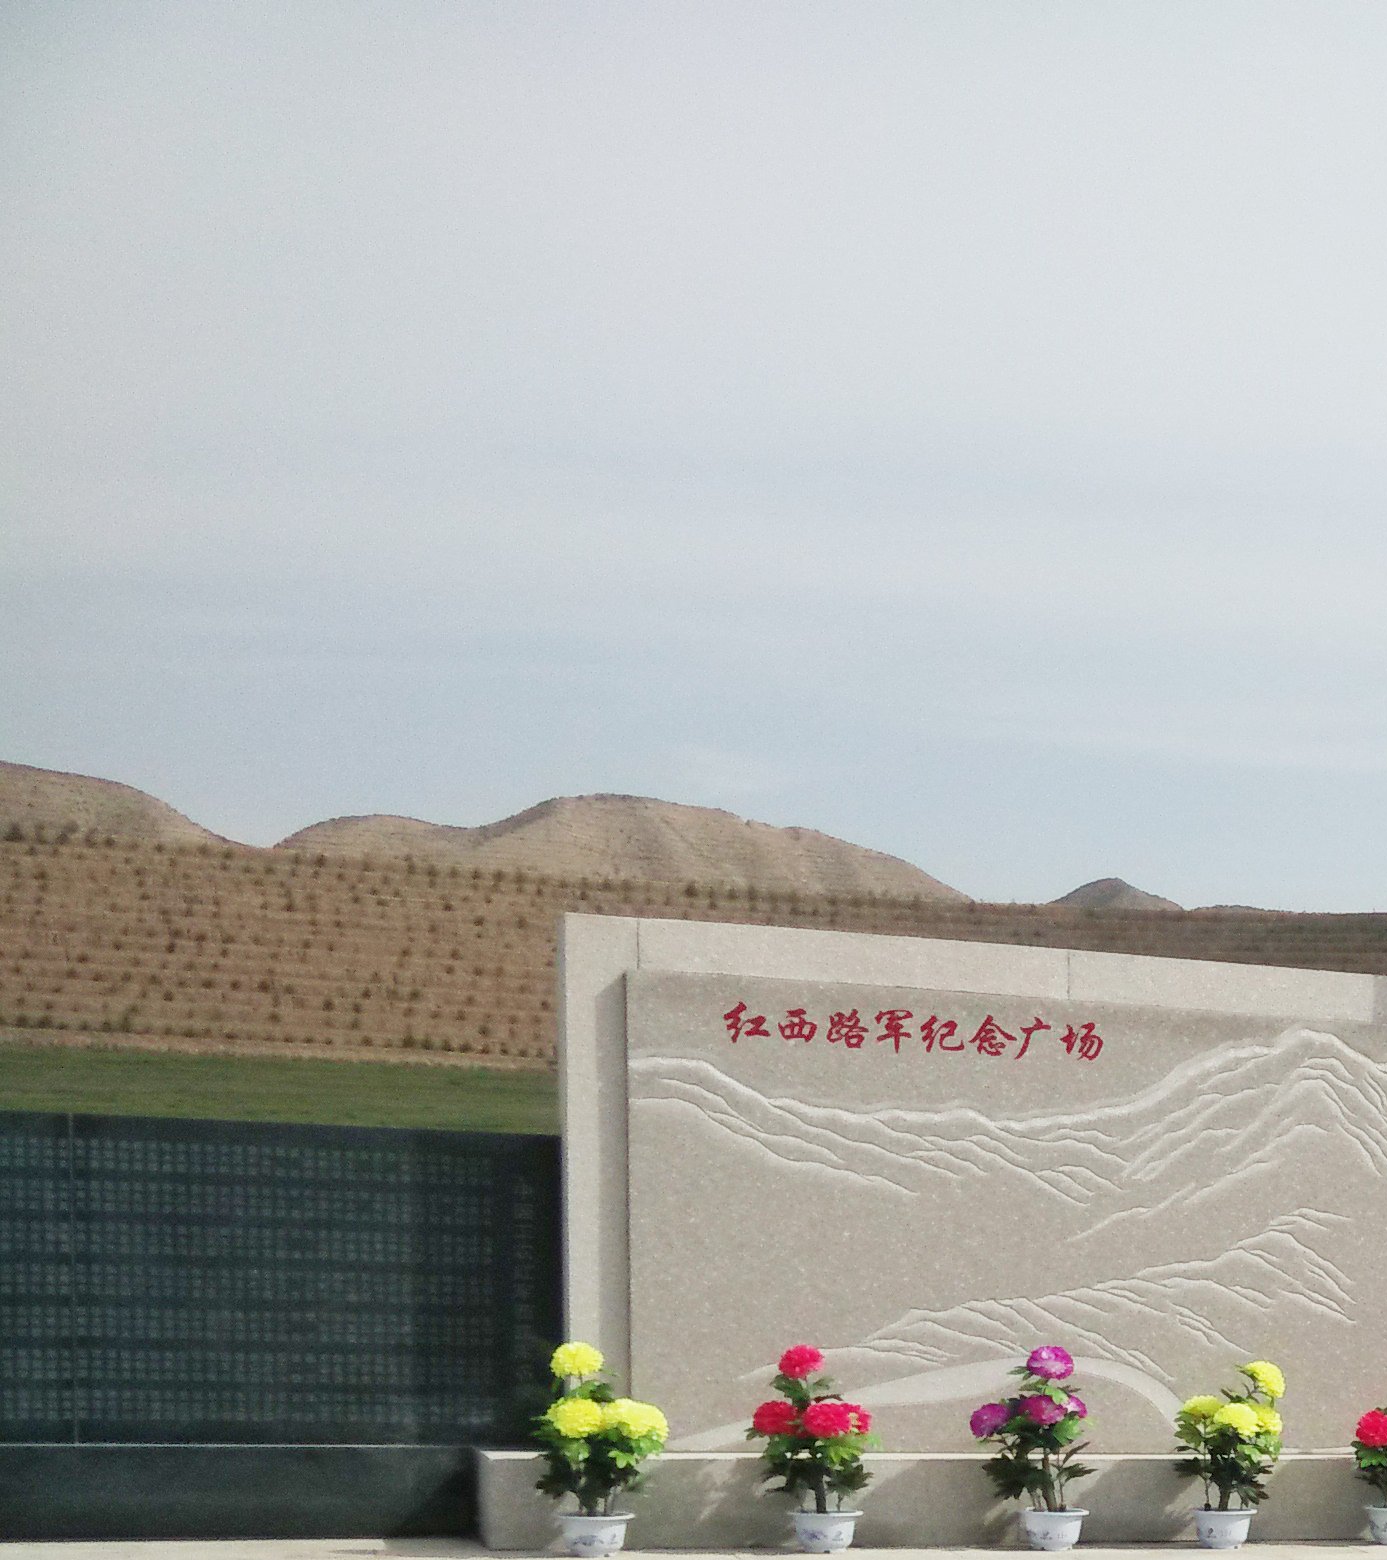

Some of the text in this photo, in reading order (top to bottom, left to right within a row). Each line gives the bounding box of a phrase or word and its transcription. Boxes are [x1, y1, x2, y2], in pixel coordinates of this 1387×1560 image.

[723, 1000, 1104, 1061] 红西路军纪念广场
